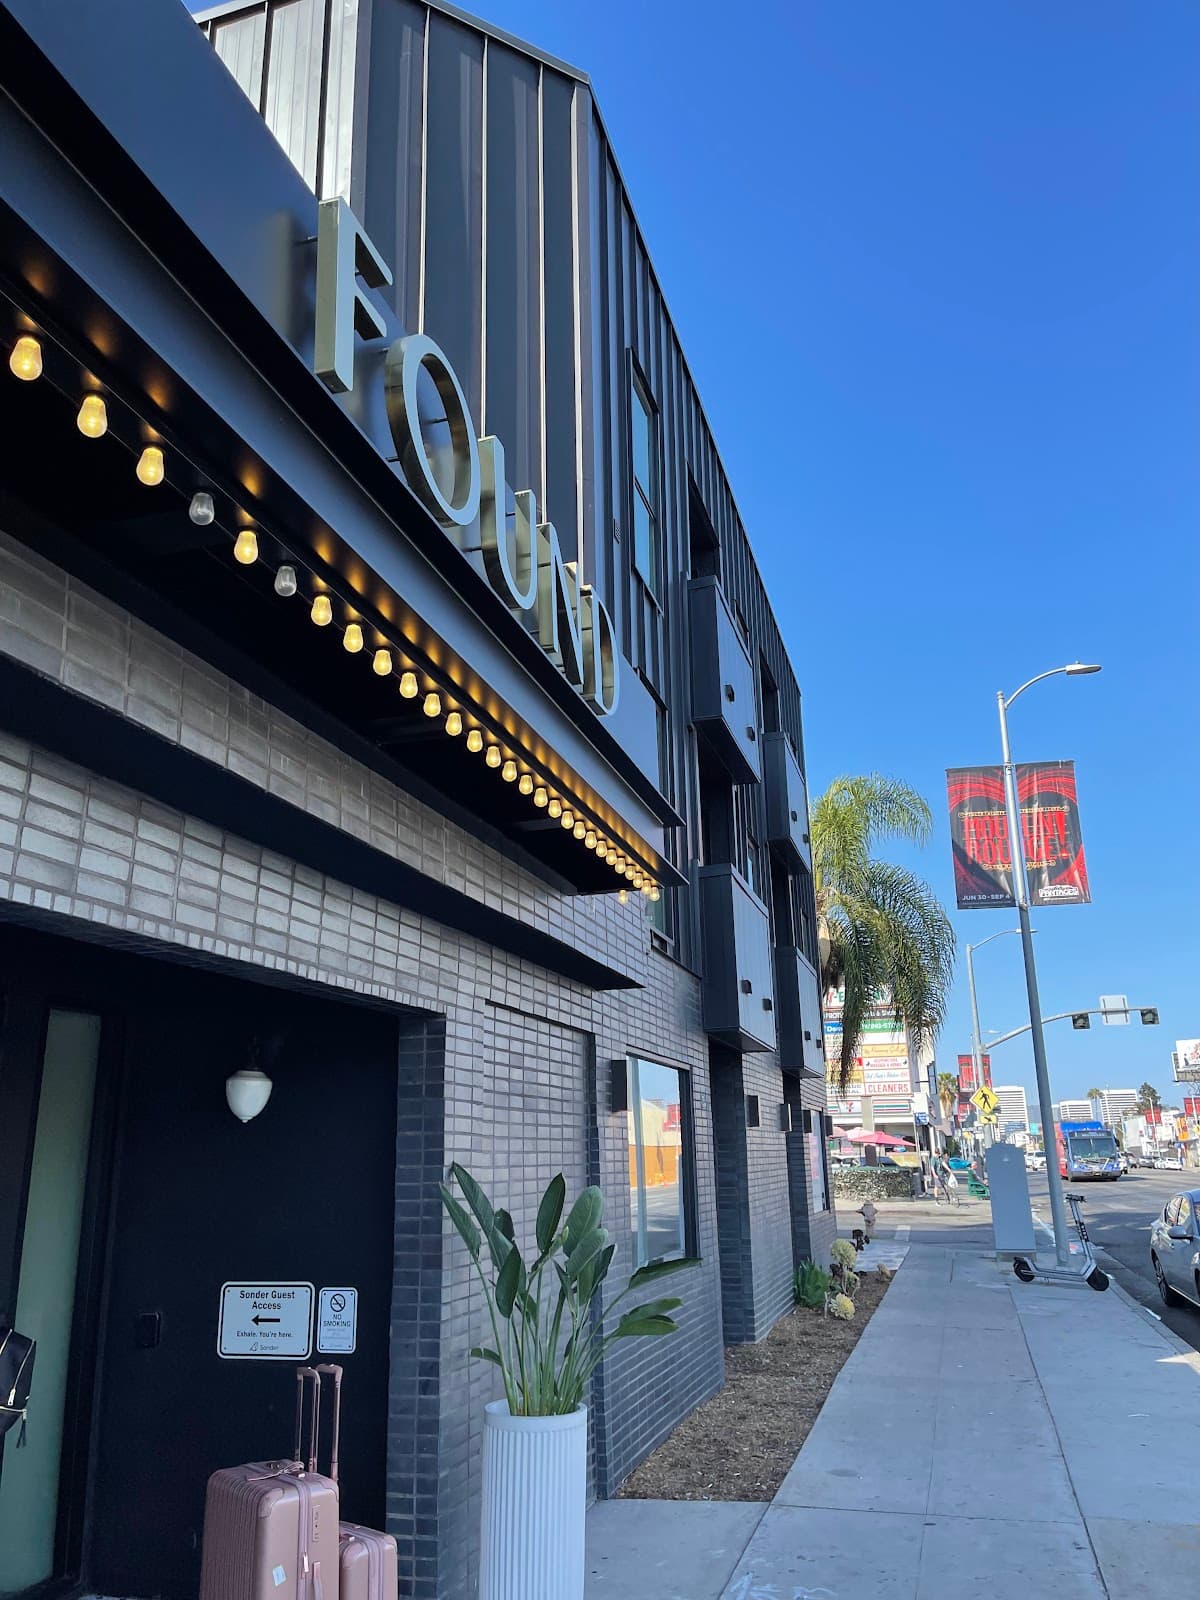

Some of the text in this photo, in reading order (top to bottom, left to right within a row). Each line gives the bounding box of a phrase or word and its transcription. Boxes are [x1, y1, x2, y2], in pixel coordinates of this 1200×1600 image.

[314, 196, 620, 716] FOUND
[868, 1083, 909, 1093] CLEANERS
[240, 1290, 296, 1299] Sonder Guest
[252, 1301, 282, 1310] Access
